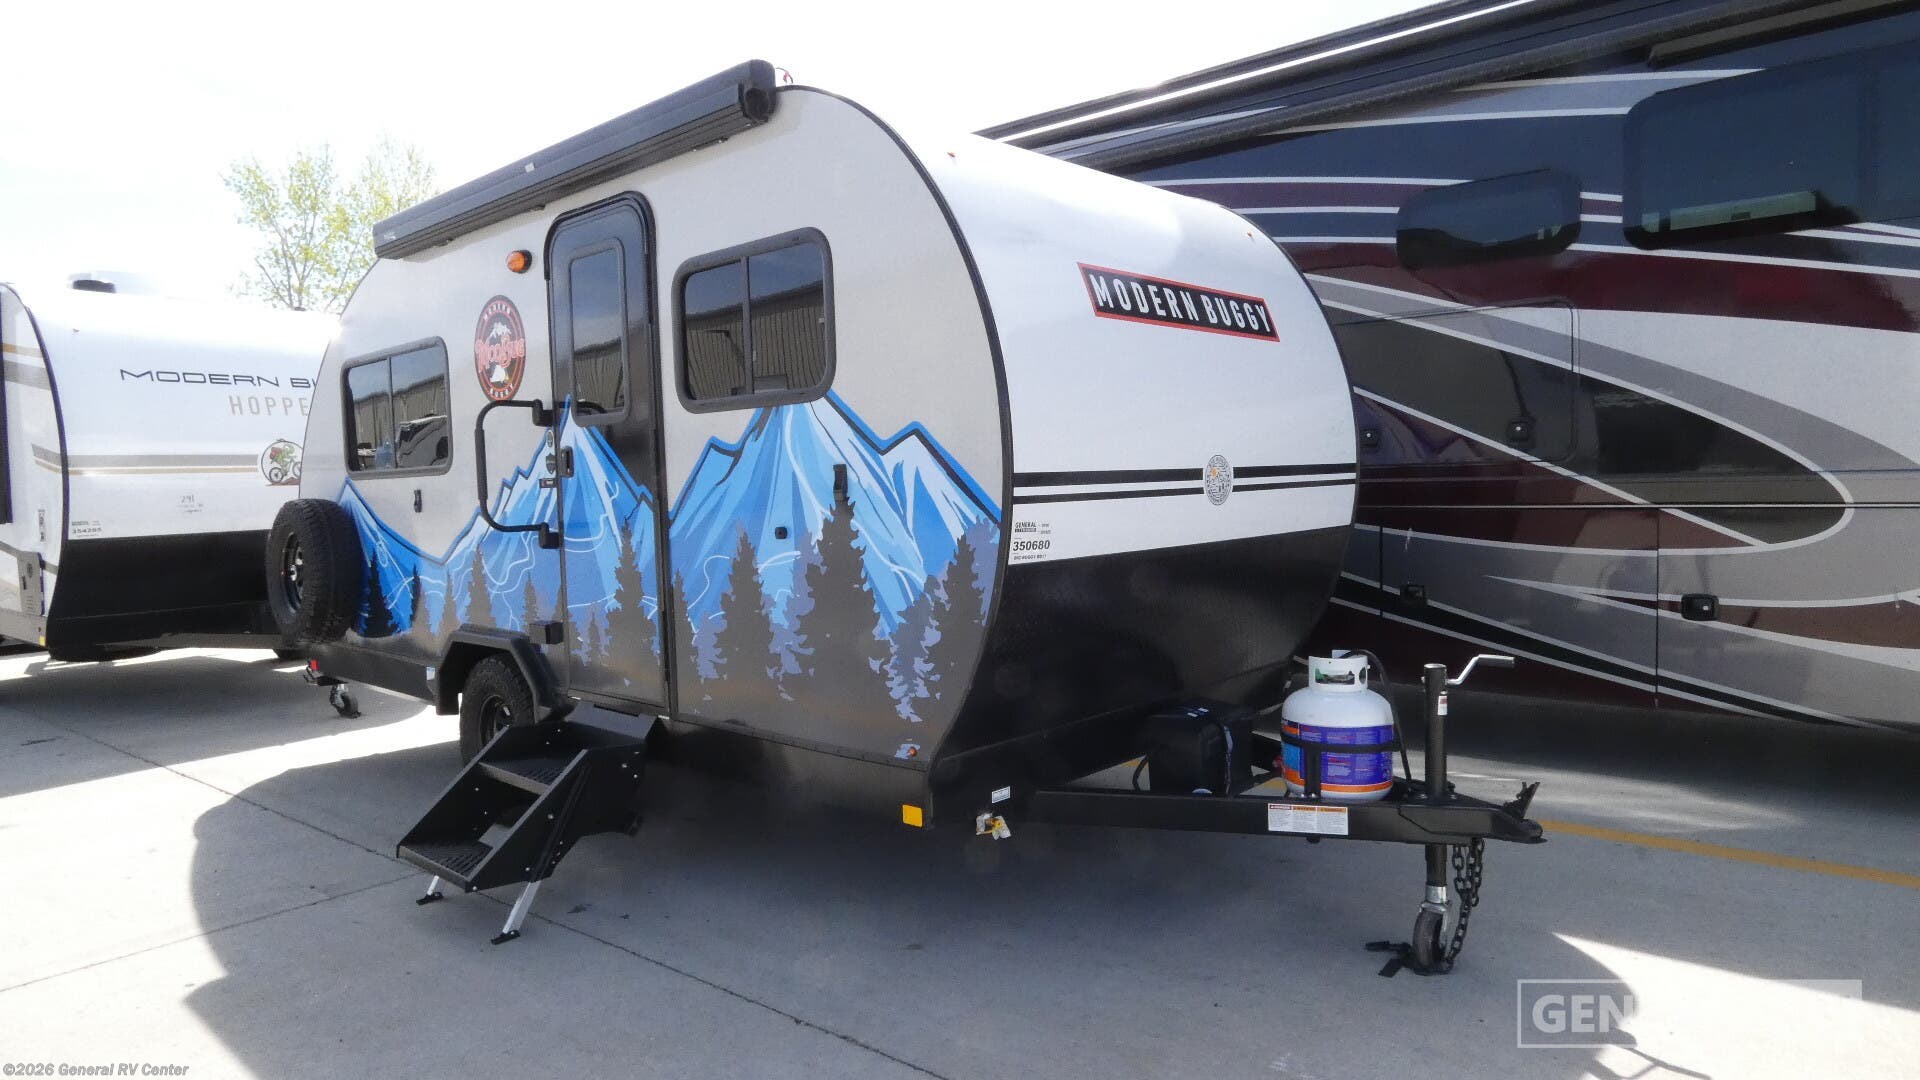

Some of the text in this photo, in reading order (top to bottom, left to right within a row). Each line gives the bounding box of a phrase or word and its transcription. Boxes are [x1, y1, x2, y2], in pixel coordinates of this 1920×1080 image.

[1089, 273, 1272, 333] MODERN BUGGY
[120, 368, 280, 387] MODERN
[1012, 539, 1051, 551] 350680
